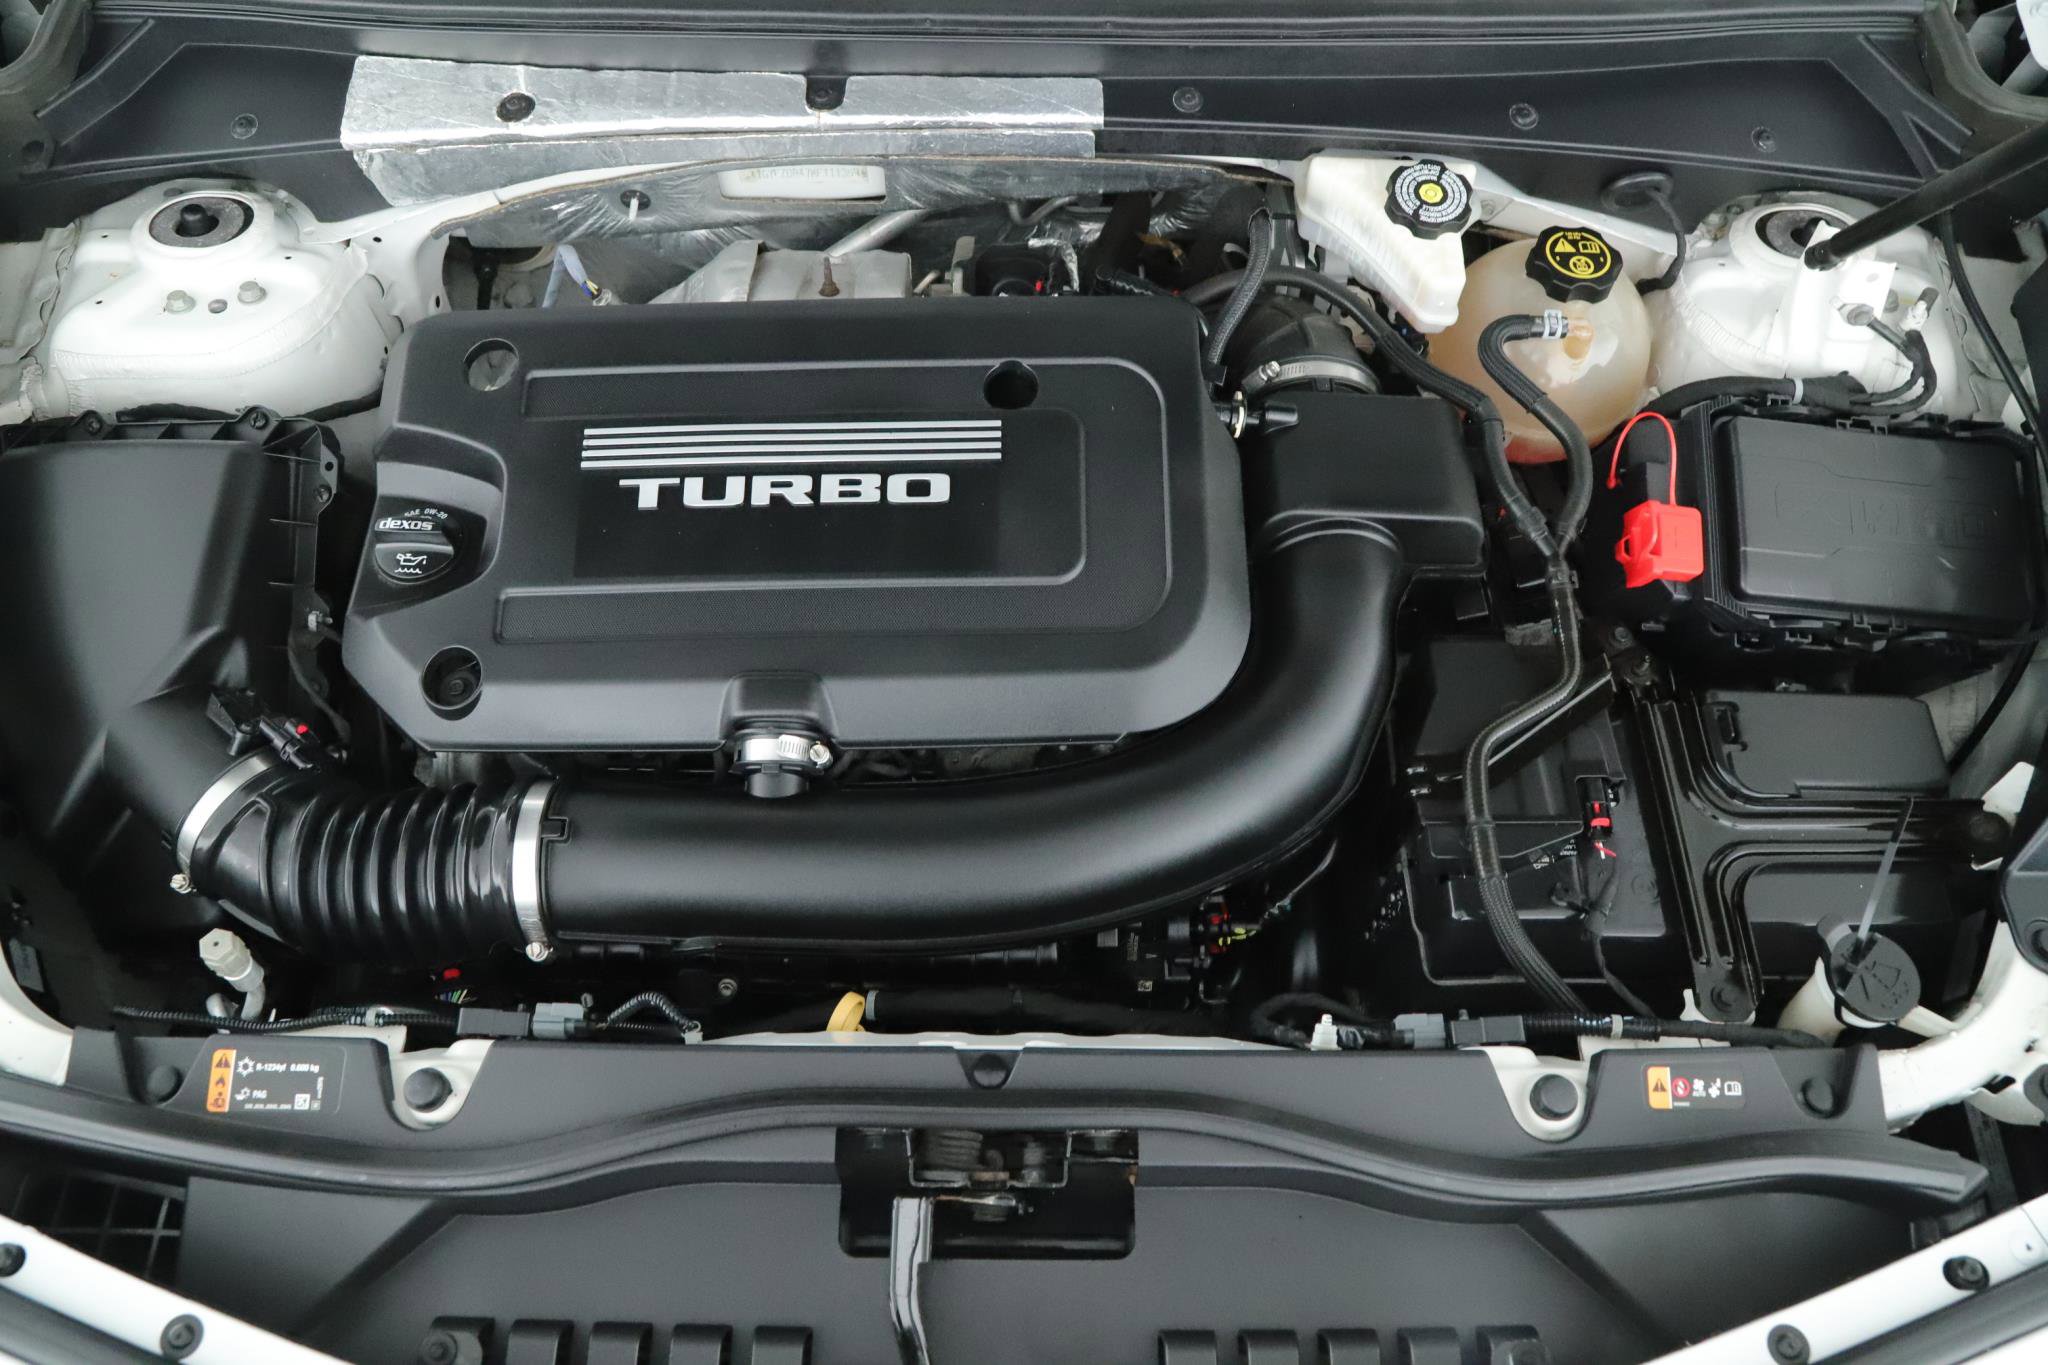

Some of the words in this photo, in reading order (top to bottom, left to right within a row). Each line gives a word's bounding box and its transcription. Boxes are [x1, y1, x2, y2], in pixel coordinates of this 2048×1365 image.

[619, 473, 951, 510] TURBO
[424, 508, 448, 519] 0W-20
[379, 517, 435, 531] dexos
